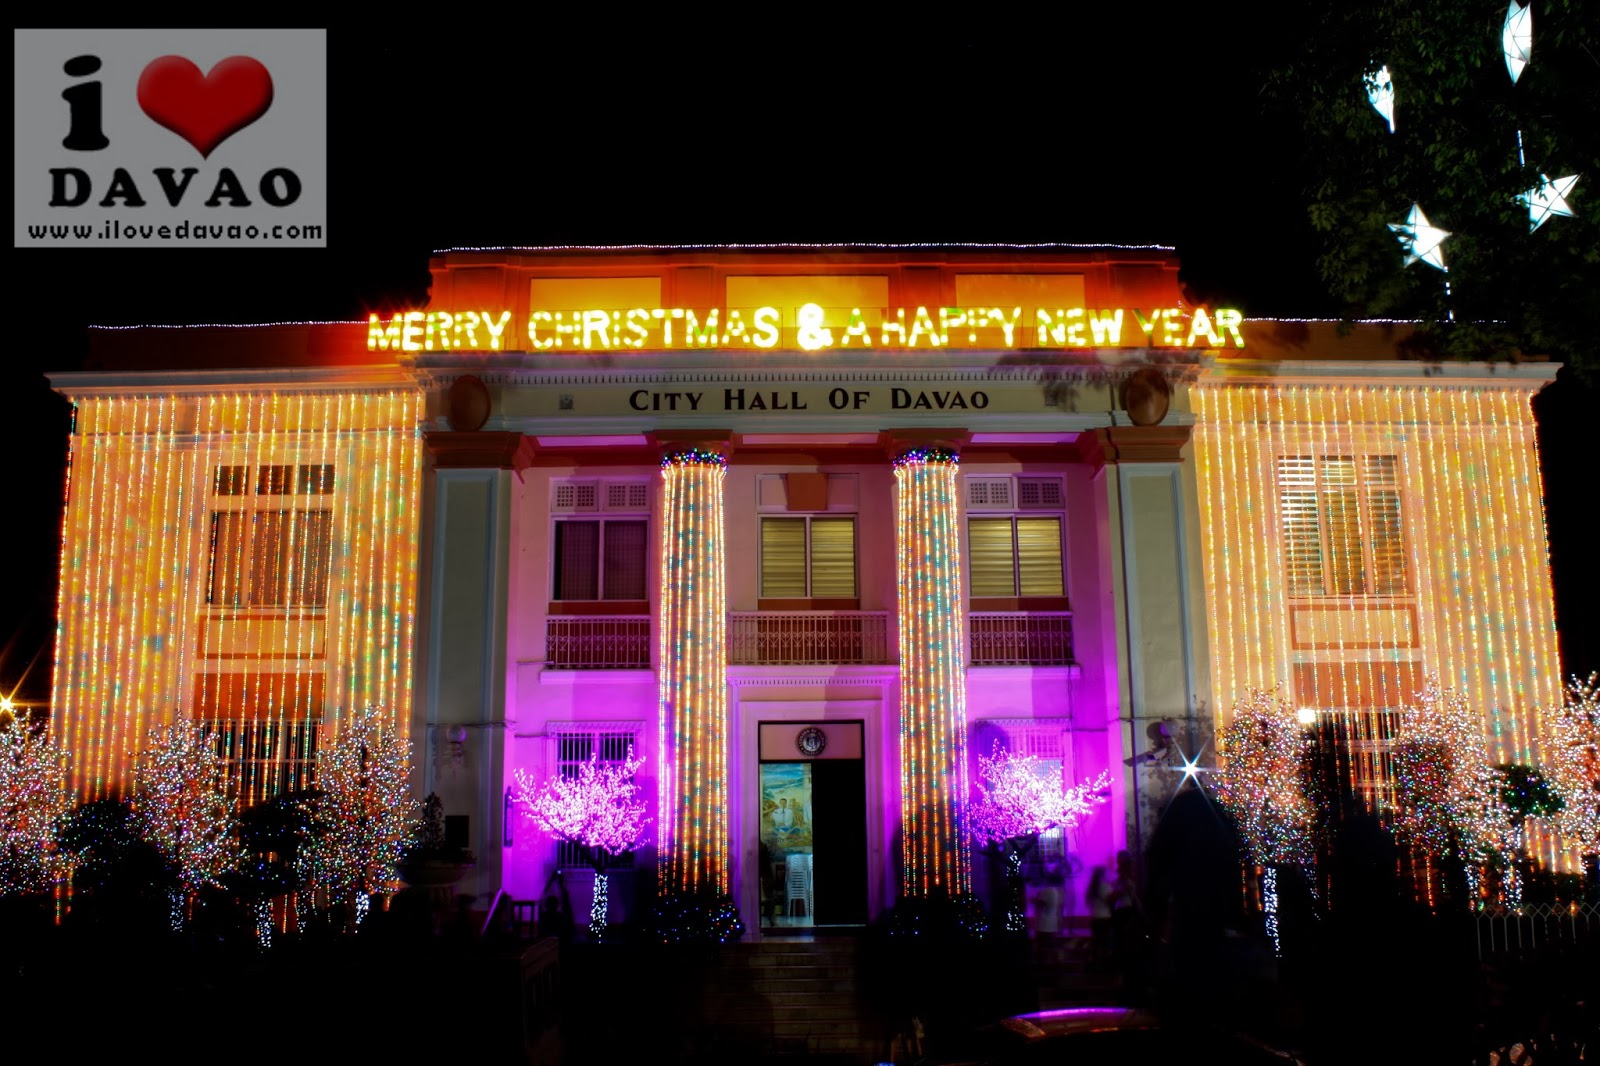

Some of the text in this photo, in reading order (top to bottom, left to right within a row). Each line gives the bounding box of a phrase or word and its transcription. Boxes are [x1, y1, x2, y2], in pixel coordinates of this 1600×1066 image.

[367, 302, 1245, 351] MERRY CHRISTMAS & A HAPPY NEW YEAR
[629, 388, 989, 411] CITY HALL OF DAVAO
